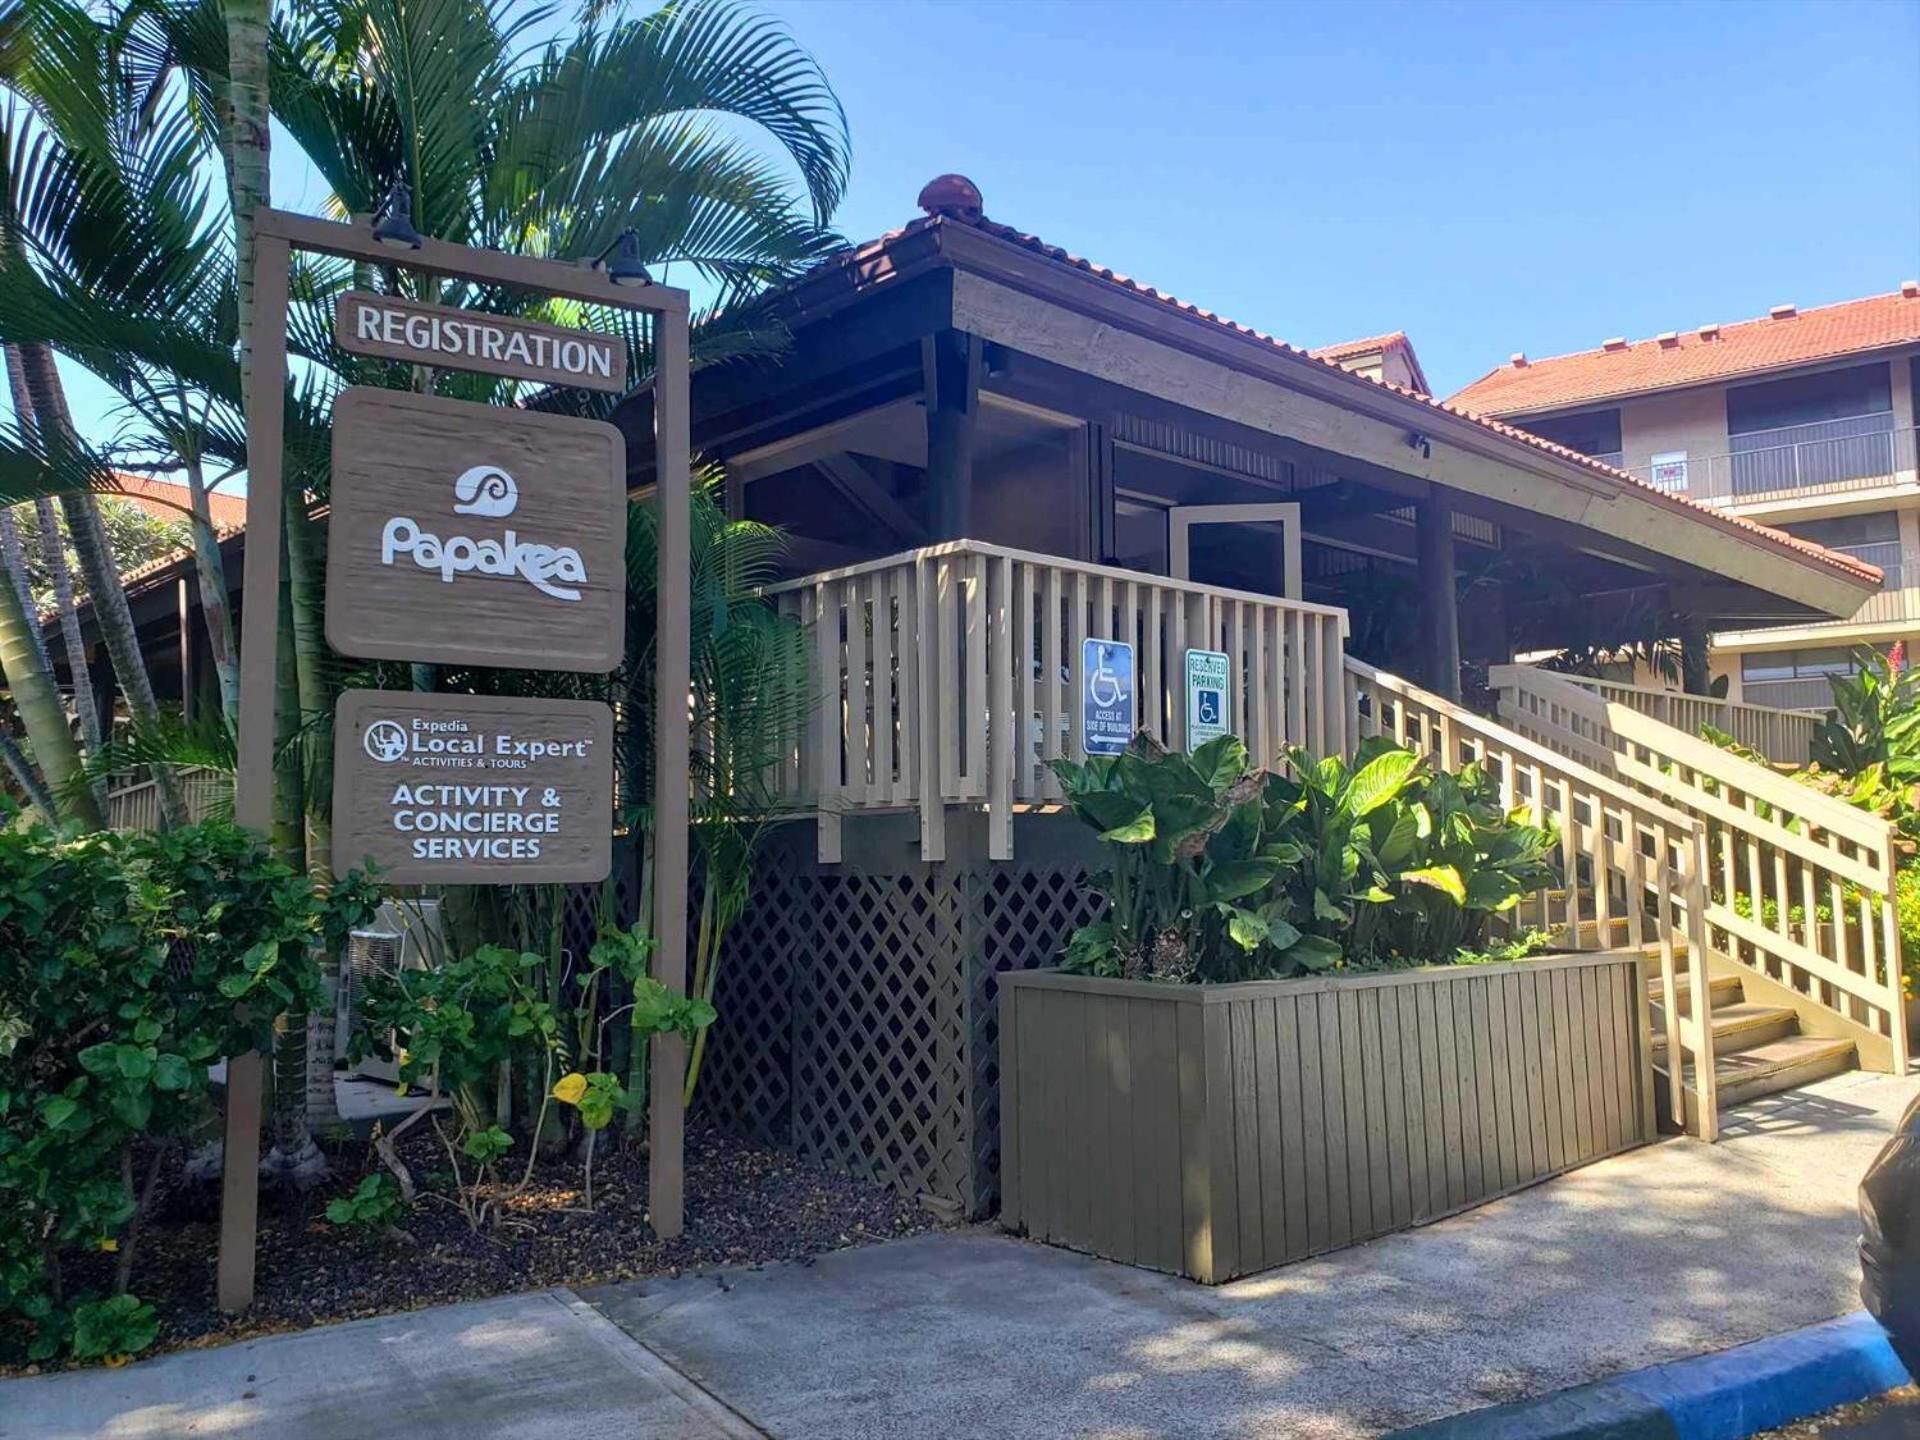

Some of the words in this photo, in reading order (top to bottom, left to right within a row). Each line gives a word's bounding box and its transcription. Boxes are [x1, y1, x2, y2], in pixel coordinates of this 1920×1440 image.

[357, 305, 611, 377] REGISTRATION
[381, 517, 587, 600] Papakea
[1190, 658, 1226, 674] RESERVED
[1192, 674, 1225, 690] PARKING
[1095, 710, 1115, 721] ACCESS
[1116, 711, 1122, 721] AT
[413, 718, 468, 733] Expedia
[1086, 720, 1098, 731] SIDE
[1099, 721, 1106, 732] OF
[1107, 722, 1131, 734] BUILDING
[412, 733, 484, 754] Local
[413, 757, 473, 769] ACTIVITIES
[476, 758, 486, 768] &
[490, 759, 527, 769] TOURS
[391, 785, 530, 807] ACTIVITY
[541, 787, 561, 807] &
[394, 810, 560, 833] CONCIERGE
[413, 838, 540, 859] SERVICES
